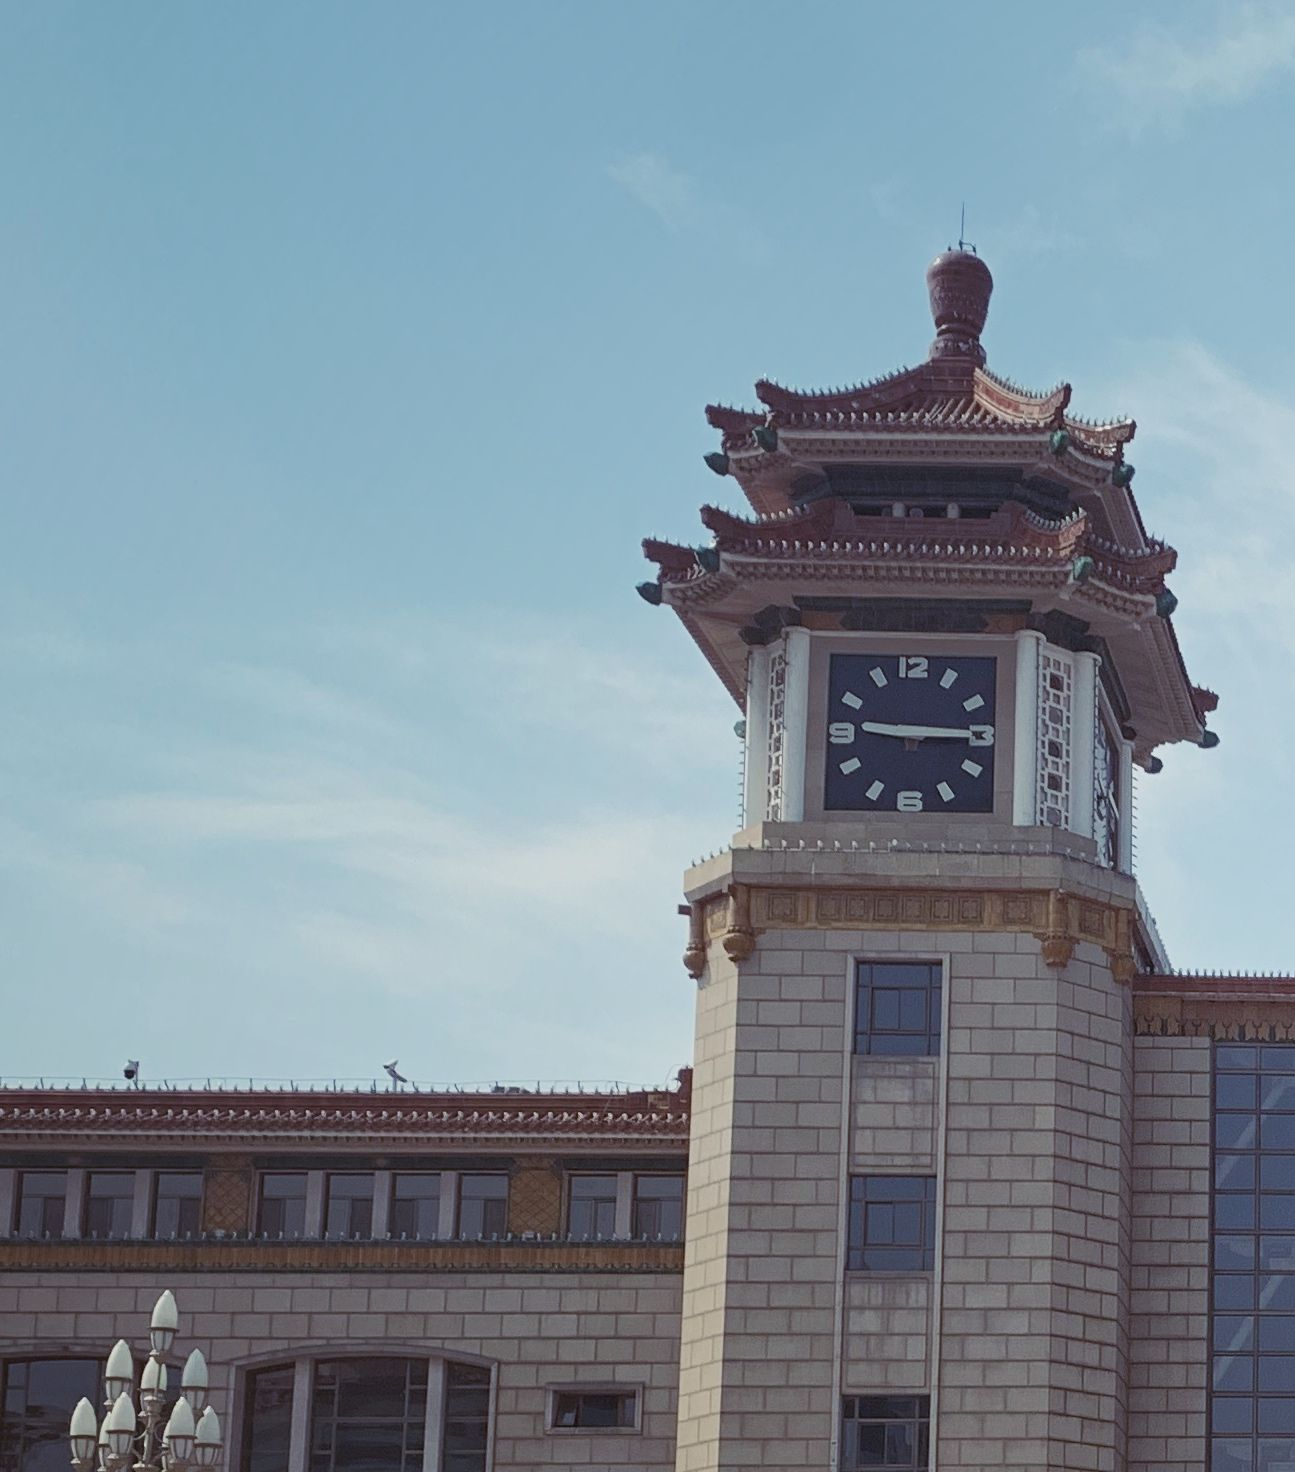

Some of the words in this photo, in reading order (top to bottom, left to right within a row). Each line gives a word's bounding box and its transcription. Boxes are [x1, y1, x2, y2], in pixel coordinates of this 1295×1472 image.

[899, 657, 928, 678] 12
[829, 722, 855, 744] 9
[969, 724, 994, 746] 3
[897, 790, 922, 812] 6
